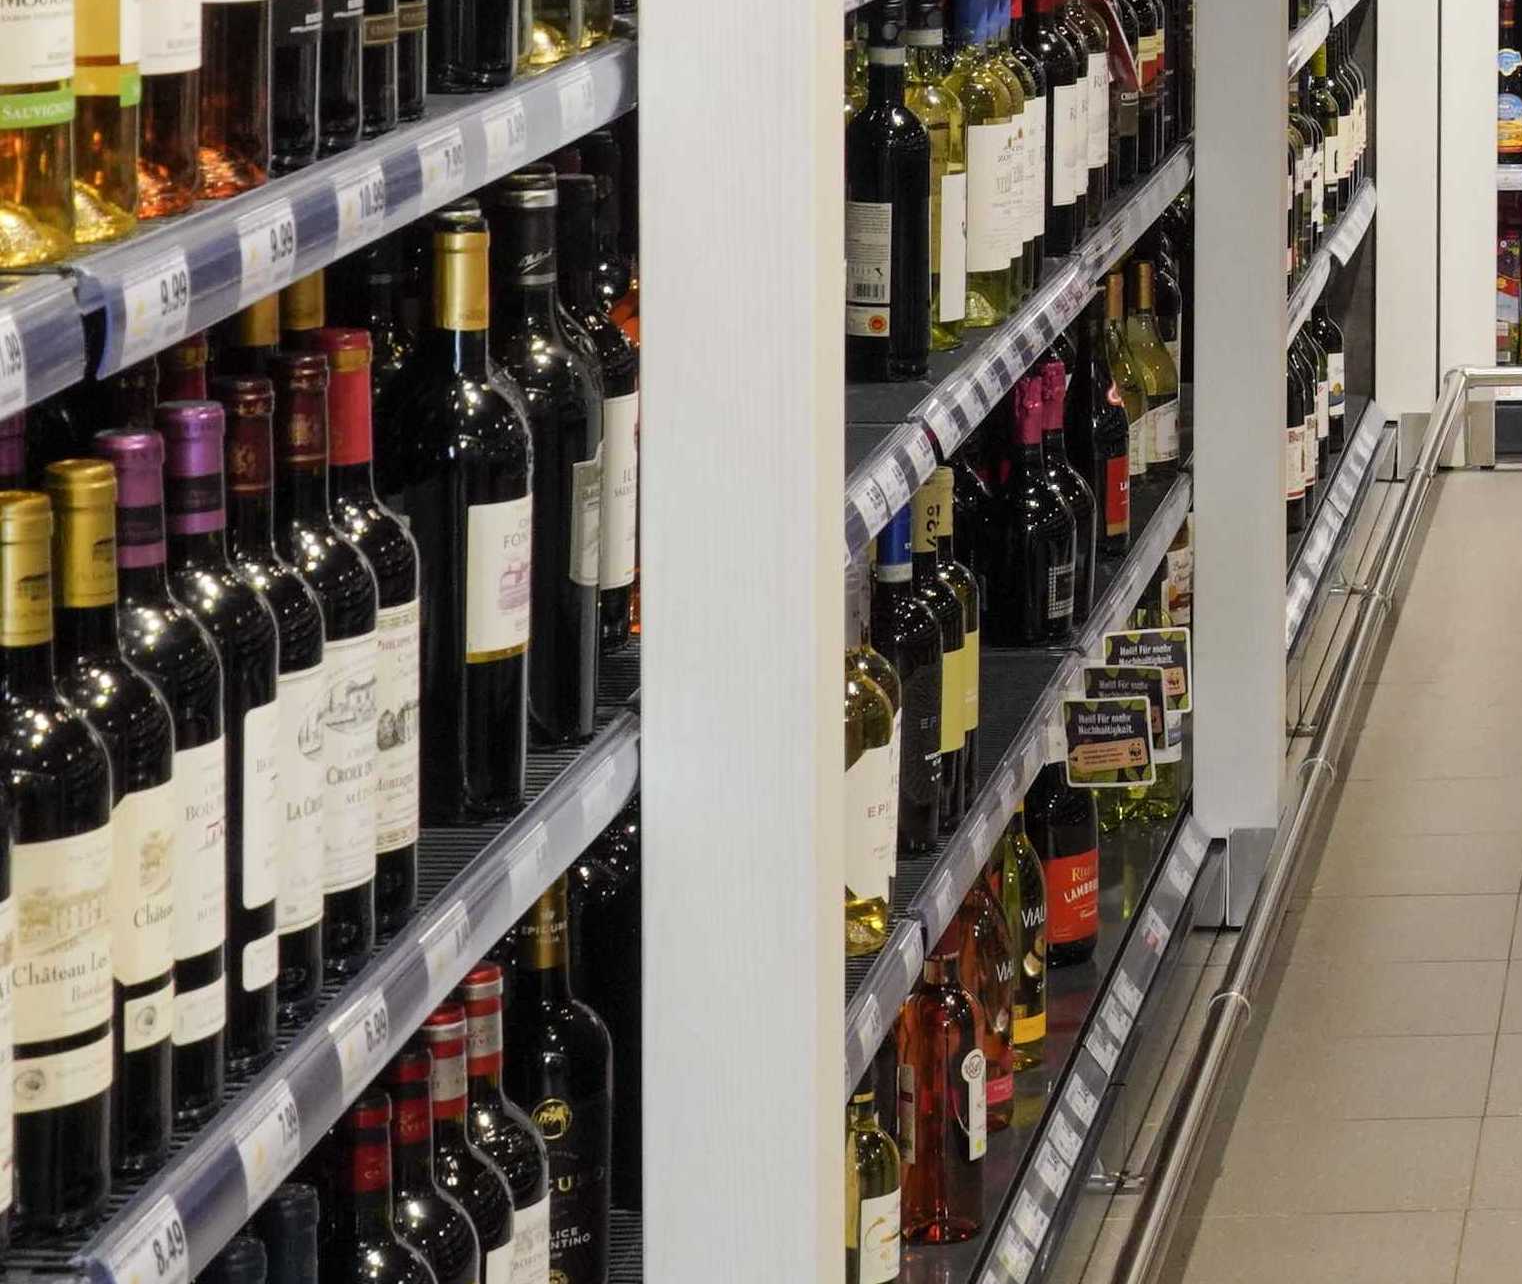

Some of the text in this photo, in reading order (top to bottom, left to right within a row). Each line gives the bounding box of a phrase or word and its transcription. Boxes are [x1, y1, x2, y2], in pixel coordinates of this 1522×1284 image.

[269, 221, 295, 262] 9.99
[160, 270, 189, 316] 9.99
[152, 1218, 184, 1277] 8.49
